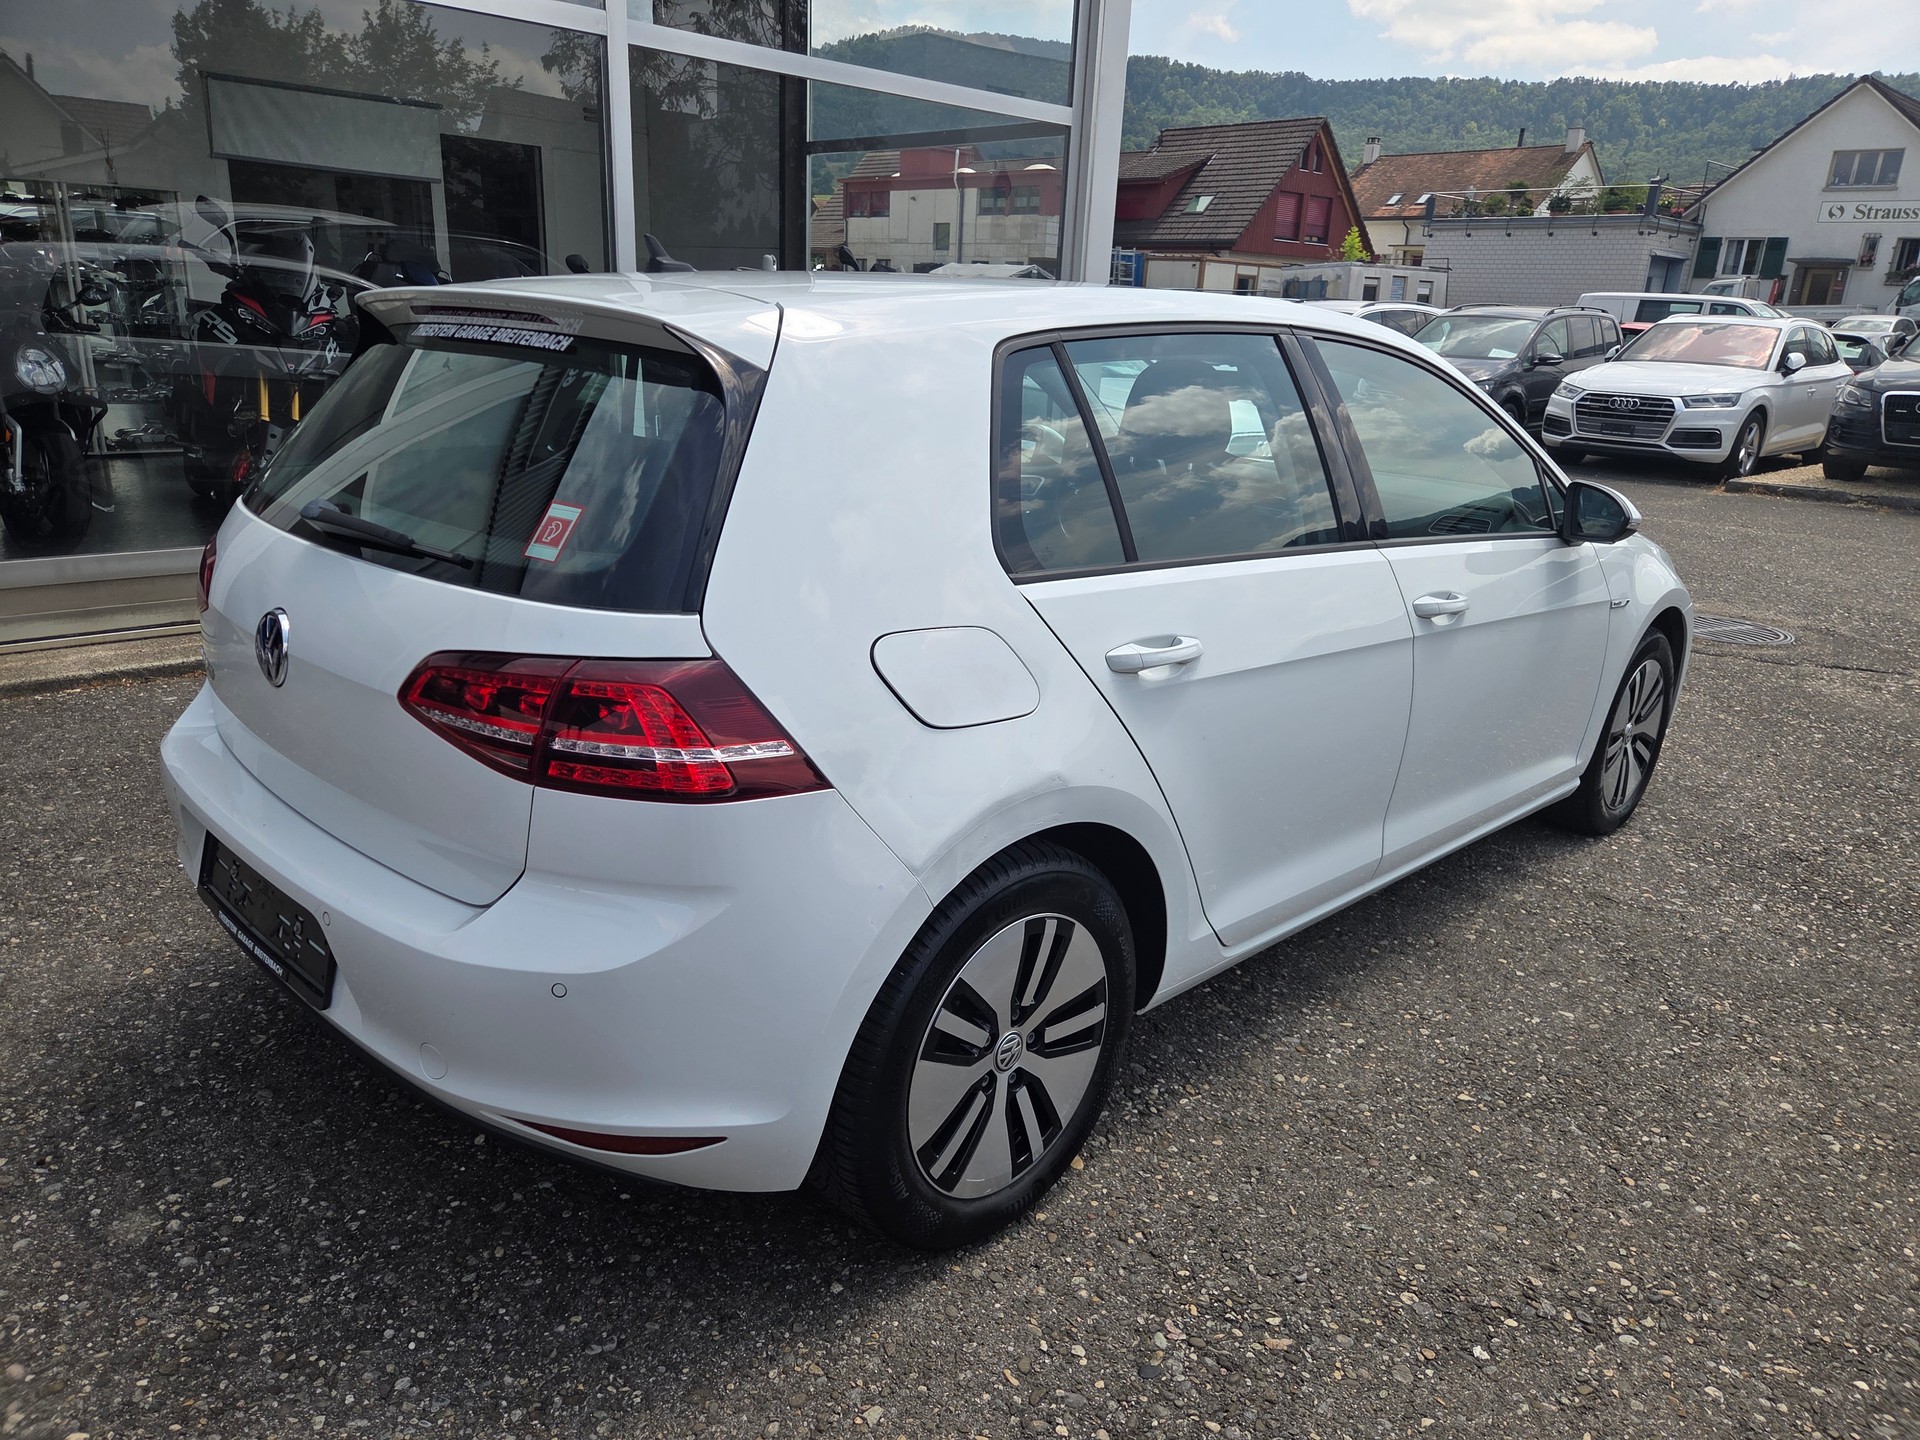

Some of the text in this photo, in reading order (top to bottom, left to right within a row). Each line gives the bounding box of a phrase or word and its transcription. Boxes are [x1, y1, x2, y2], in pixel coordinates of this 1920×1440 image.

[1853, 204, 1919, 220] Strauss
[411, 323, 574, 352] THIERSTEIN GARAGE BREITENBACH
[237, 930, 254, 951] GARAGE
